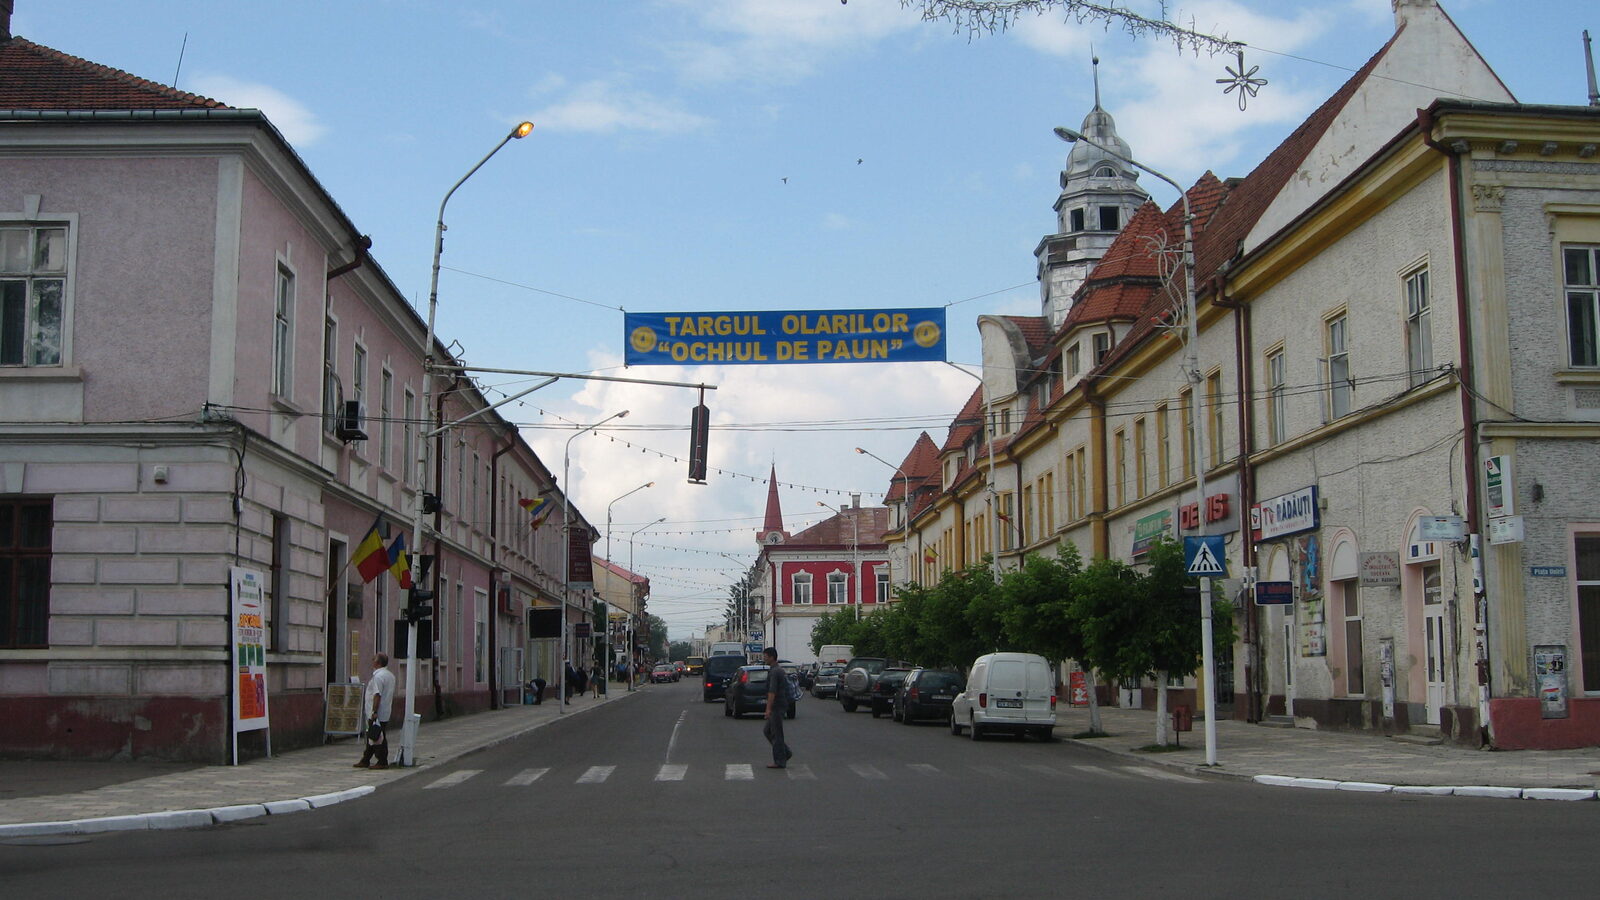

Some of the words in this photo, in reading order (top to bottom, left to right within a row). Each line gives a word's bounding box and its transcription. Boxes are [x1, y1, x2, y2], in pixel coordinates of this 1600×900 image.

[664, 315, 766, 336] TARGUL
[781, 313, 909, 335] OLARILOR
[658, 341, 768, 362] “OCHIUL
[776, 340, 809, 361] DE
[817, 338, 903, 360] PAUN”
[1263, 506, 1275, 526] TV
